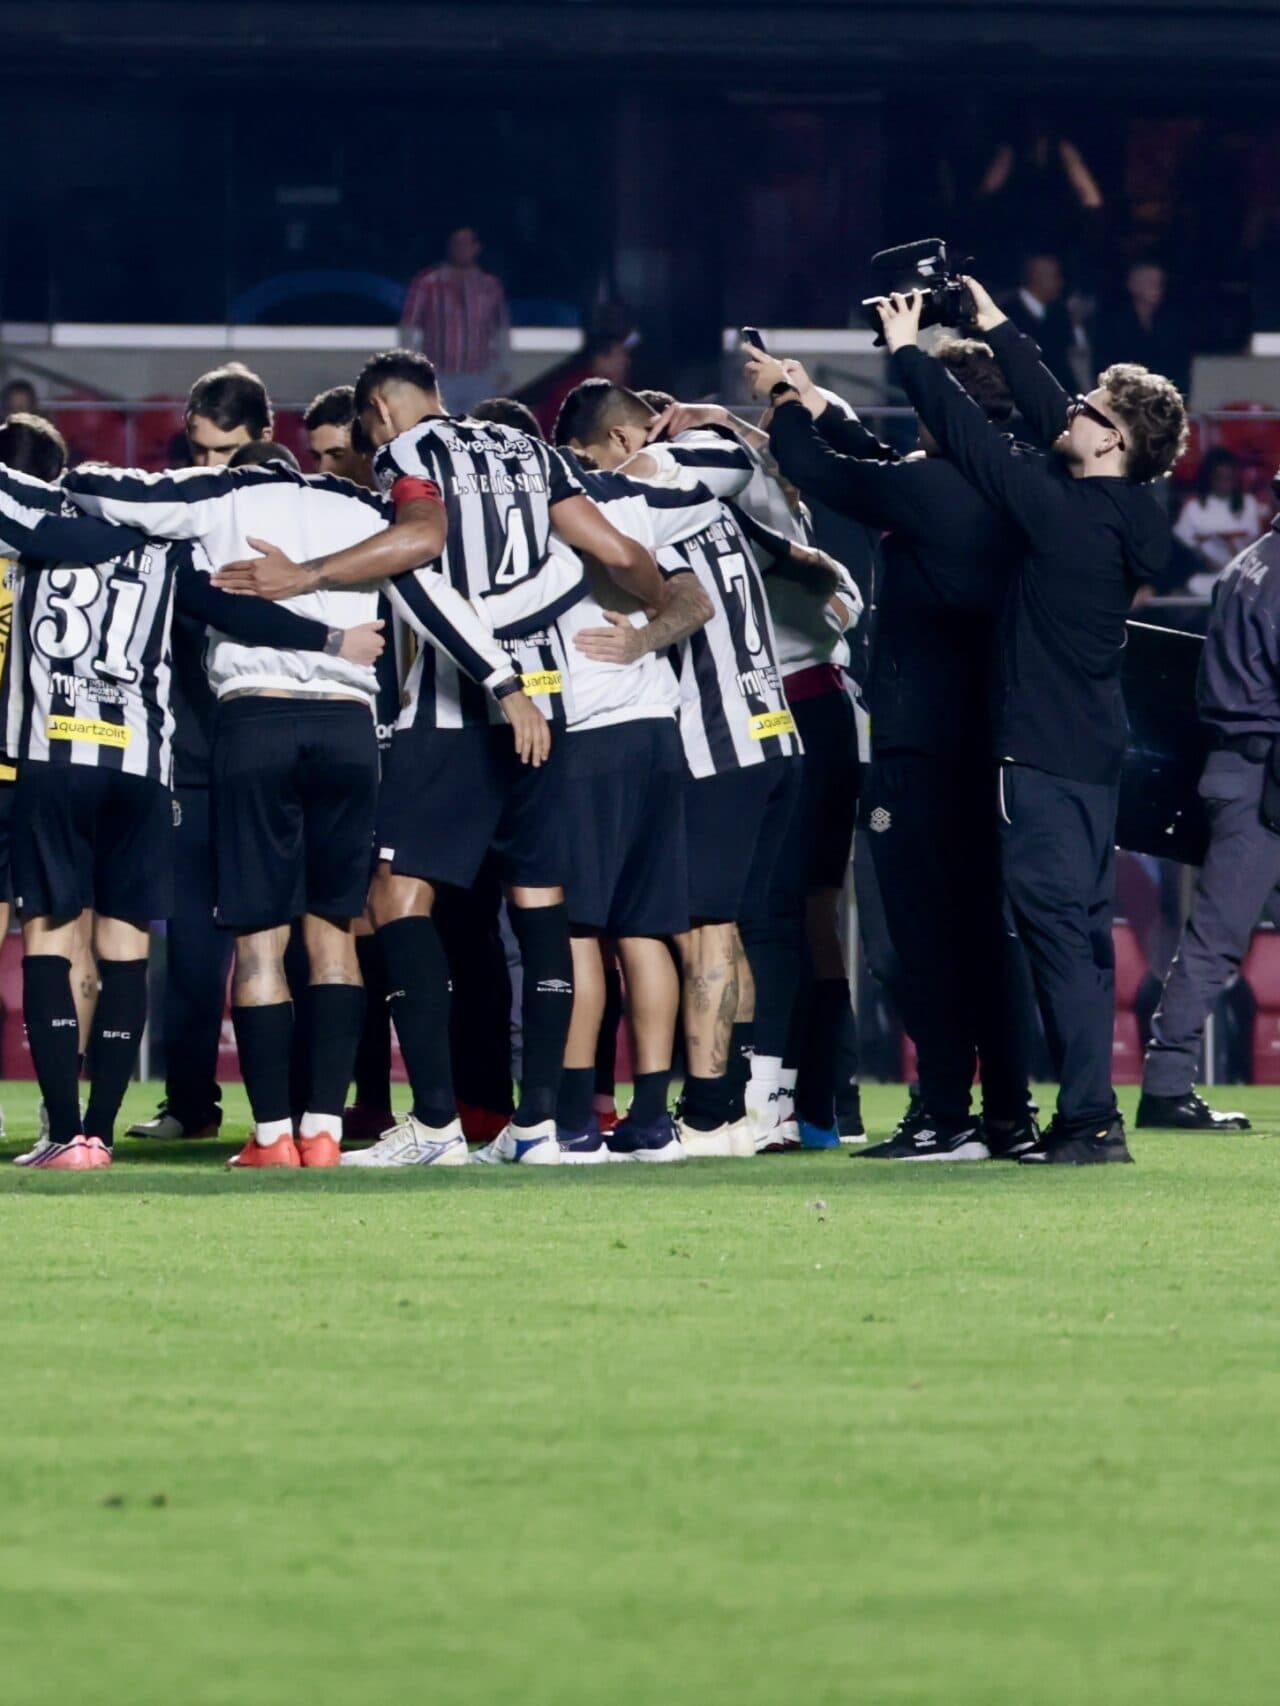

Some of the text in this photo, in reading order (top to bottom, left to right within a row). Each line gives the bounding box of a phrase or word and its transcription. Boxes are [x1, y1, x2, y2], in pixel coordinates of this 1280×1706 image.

[494, 507, 530, 585] 4
[34, 567, 146, 683] 31
[717, 551, 761, 655] 7
[59, 721, 127, 740] quartzolit
[51, 1019, 77, 1027] SFC
[102, 1030, 131, 1039] SFC
